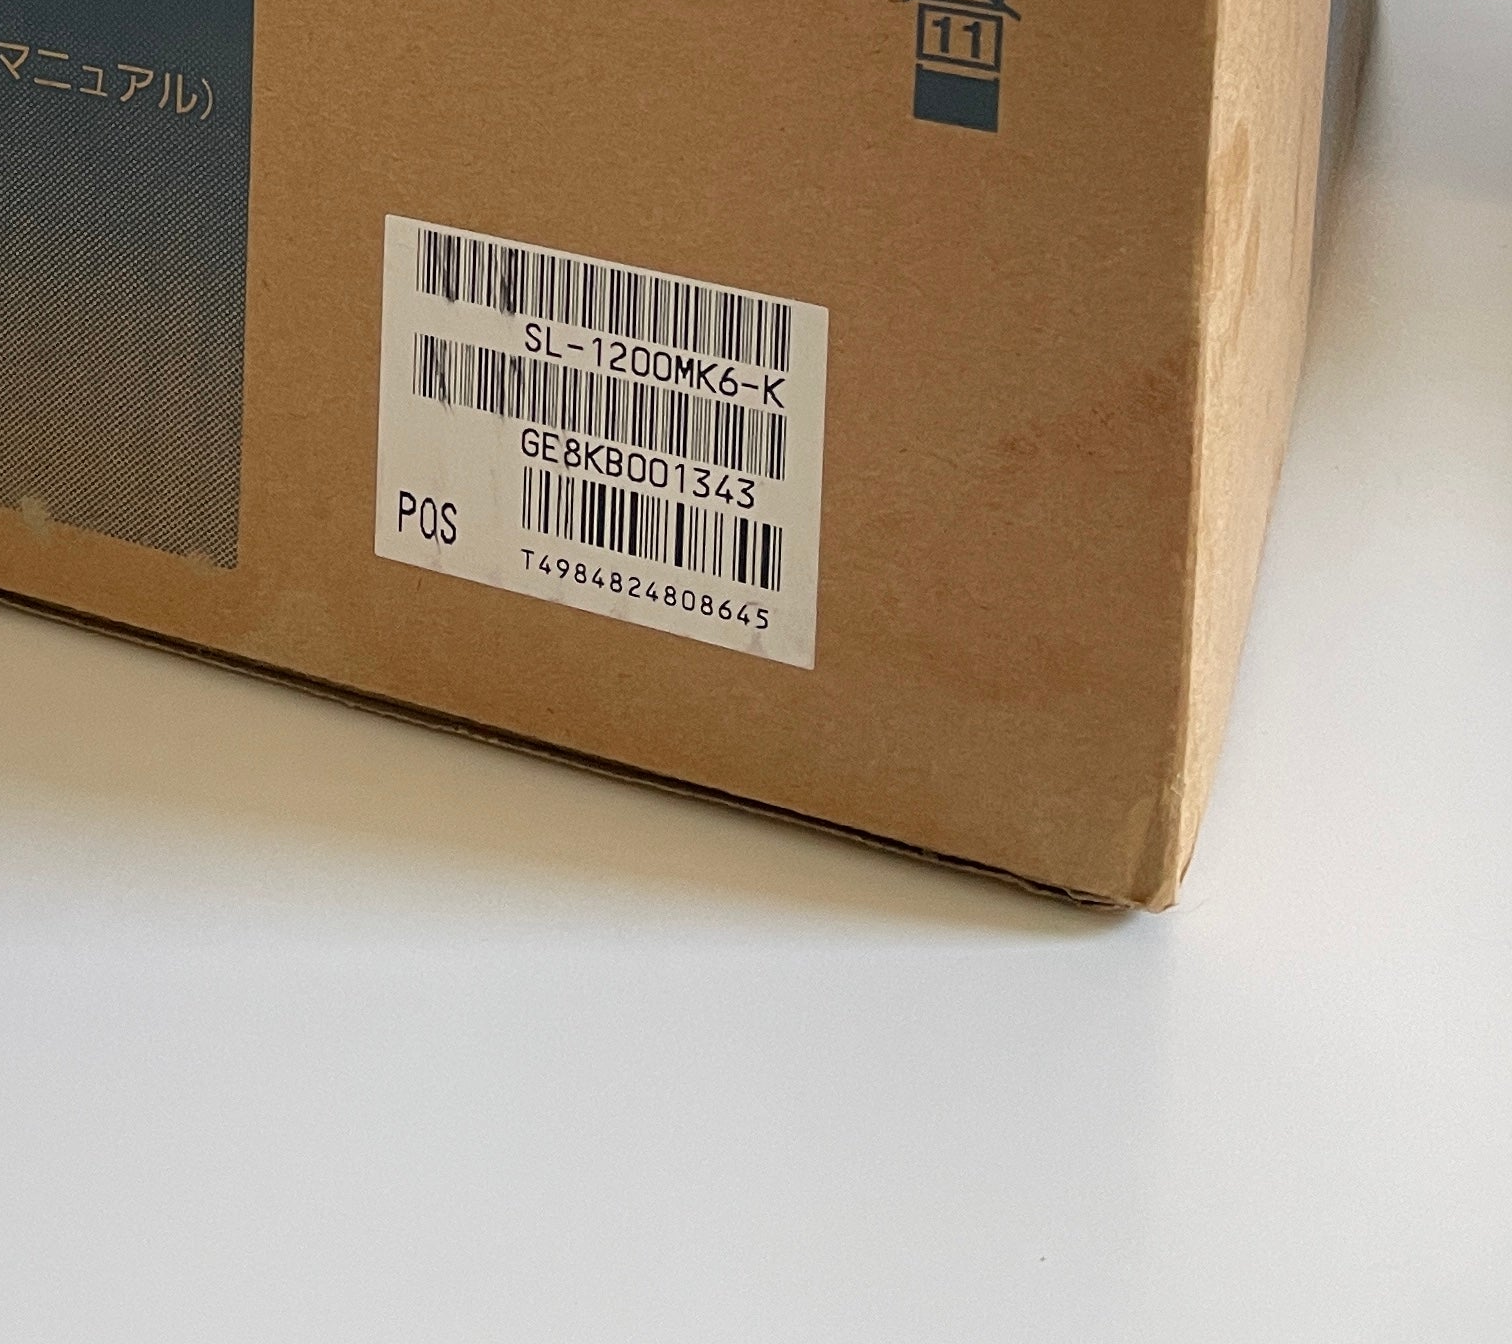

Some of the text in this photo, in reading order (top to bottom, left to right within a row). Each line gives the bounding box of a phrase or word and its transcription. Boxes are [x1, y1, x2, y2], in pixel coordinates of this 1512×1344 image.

[524, 323, 786, 408] SL-1200MK6-K
[521, 428, 756, 510] GE8KB001343
[398, 490, 458, 544] POS
[521, 549, 770, 630] T4984824808645
